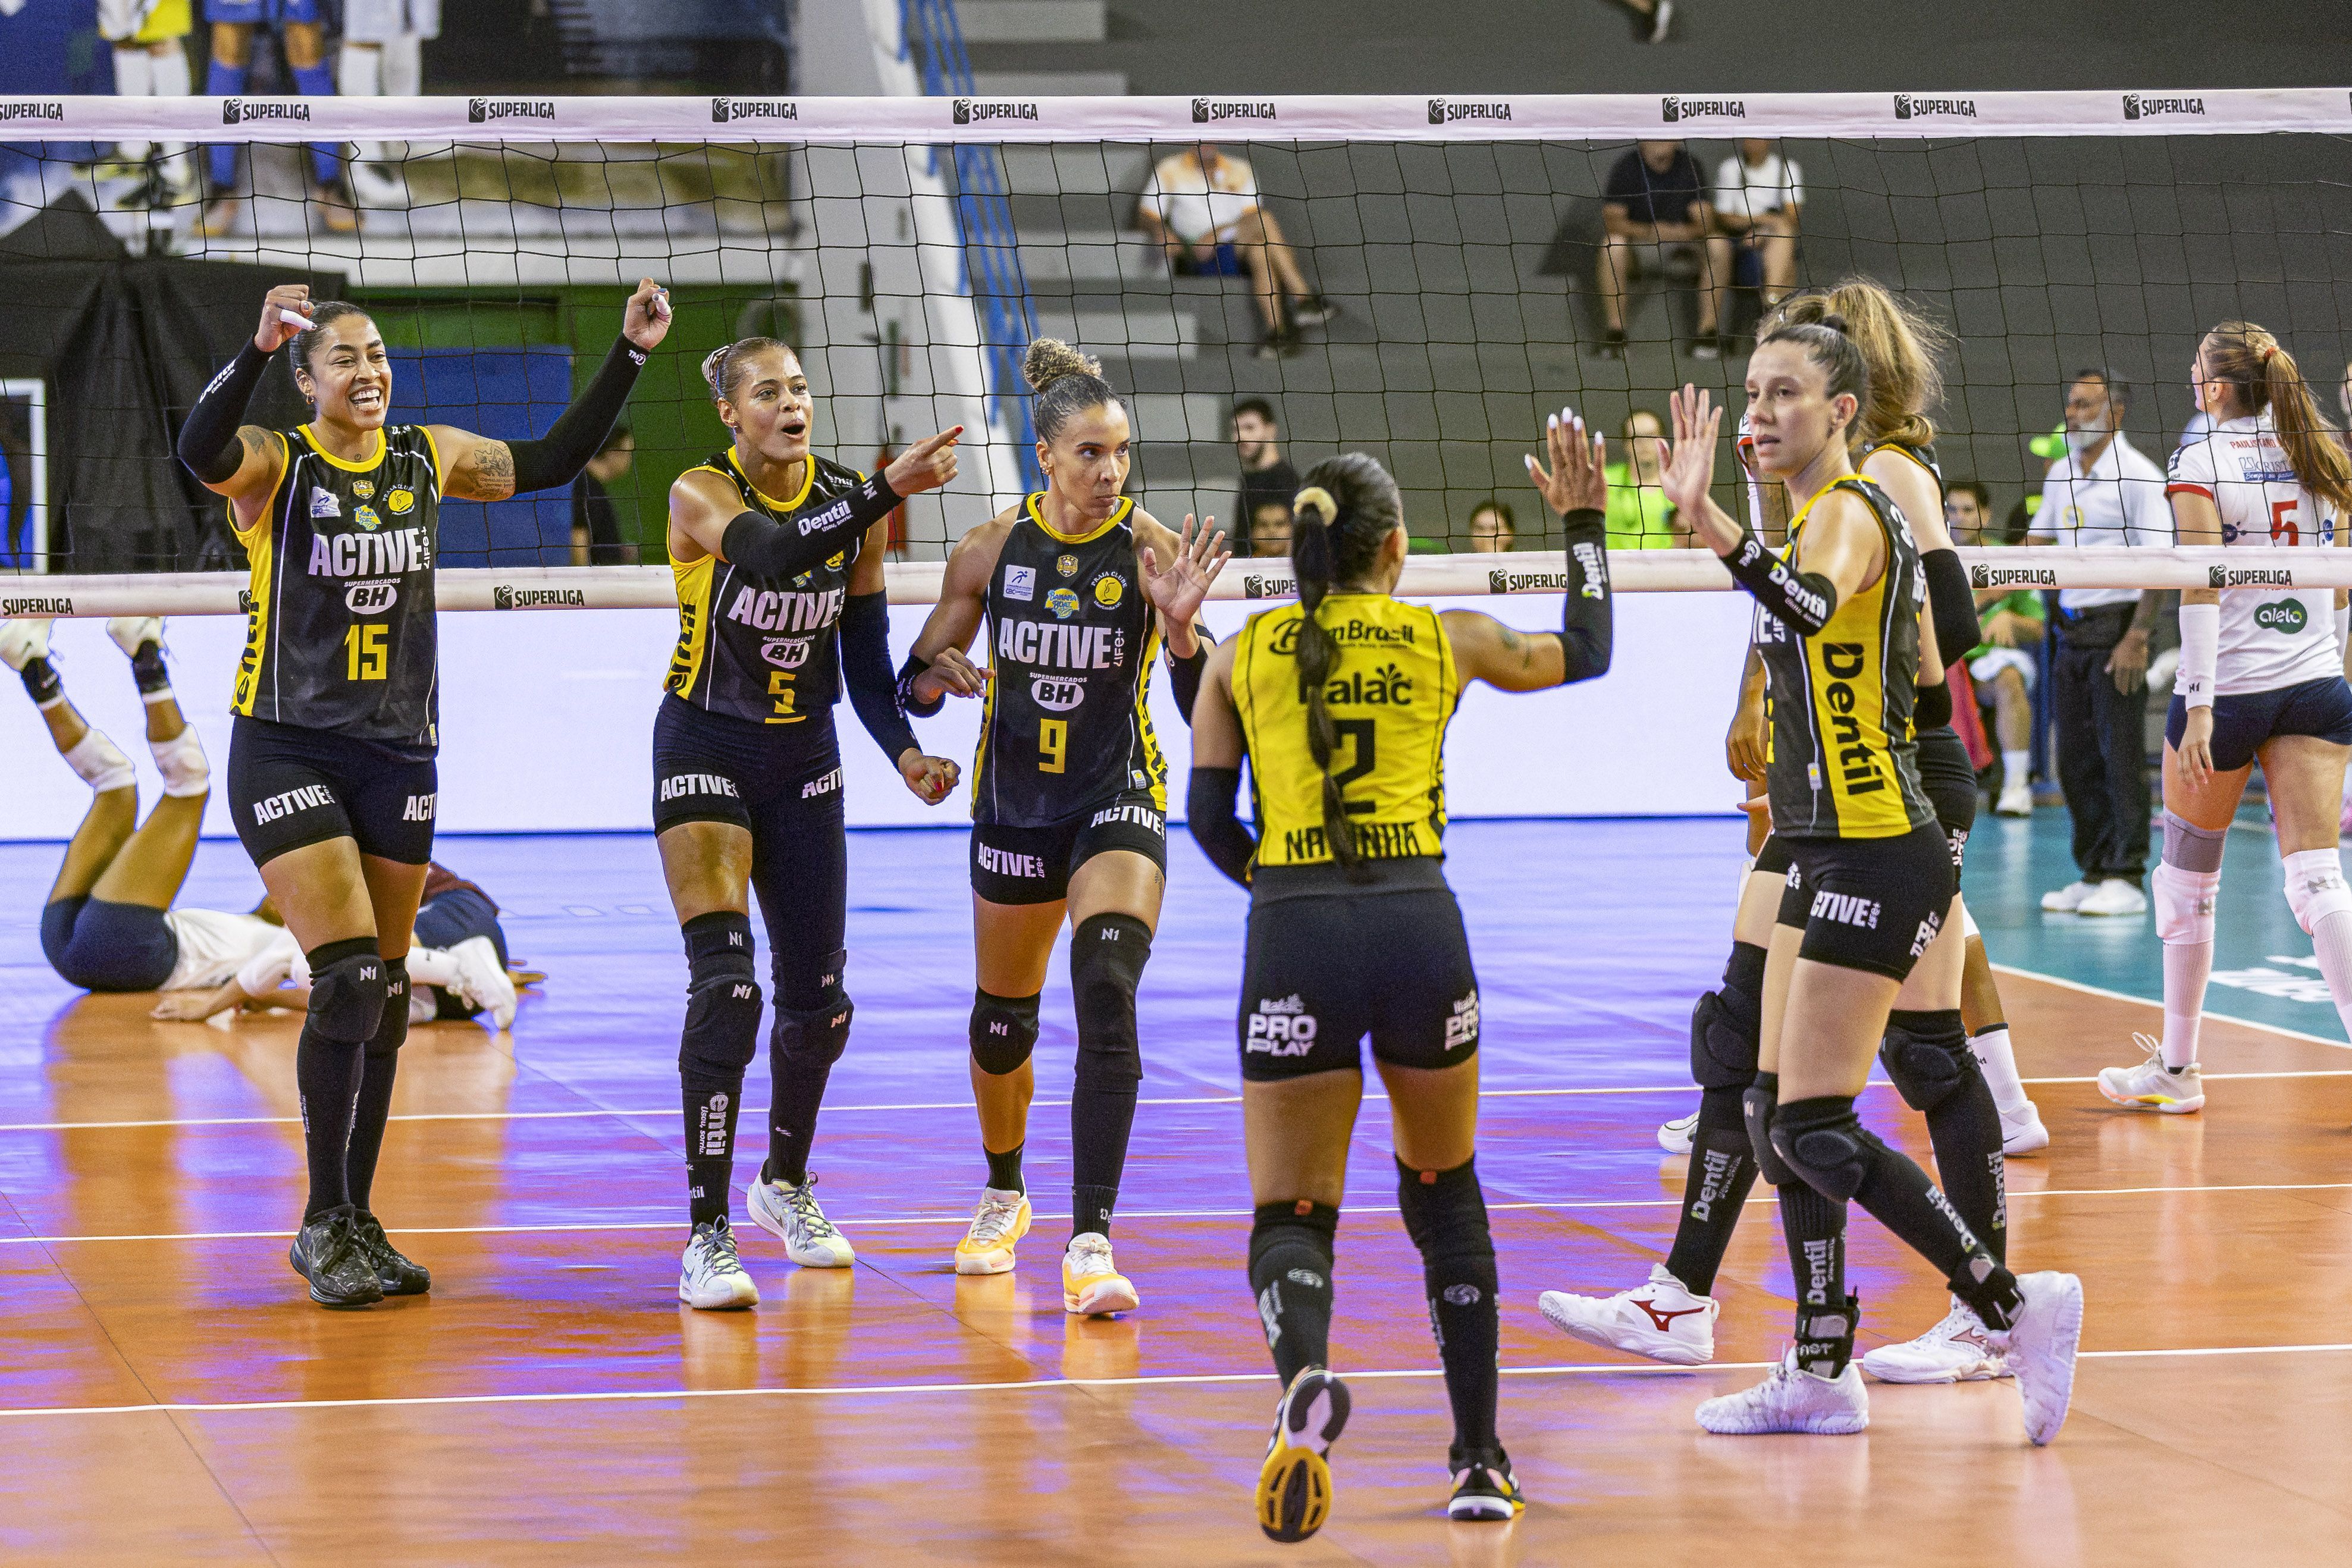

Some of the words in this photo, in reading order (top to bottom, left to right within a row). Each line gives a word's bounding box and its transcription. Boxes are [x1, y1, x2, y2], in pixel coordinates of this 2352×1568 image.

[243, 103, 310, 121] SUPERLIGA
[488, 102, 554, 120] SUPERLIGA
[732, 102, 798, 120] SUPERLIGA
[973, 103, 1039, 121] SUPERLIGA
[1212, 102, 1277, 120] SUPERLIGA
[1447, 104, 1511, 121] SUPERLIGA
[1682, 101, 1745, 118] SUPERLIGA
[1912, 99, 1977, 118] SUPERLIGA
[2141, 98, 2205, 115] SUPERLIGA
[798, 500, 851, 536] Dentil
[2272, 500, 2298, 546] 5
[308, 528, 422, 576] ACTIVE
[1091, 572, 1109, 587] PRAIA
[1111, 571, 1127, 588] CLUBE
[1573, 542, 1604, 600] Dentil
[1991, 569, 2056, 586] SUPERLIGA
[2228, 569, 2293, 586] SUPERLIGA
[344, 578, 400, 587] SUPERMERCADOS
[1509, 573, 1567, 591] SUPERLIG
[1768, 562, 1827, 620] Dentil
[2, 597, 74, 615] SUPERLIGA
[352, 587, 390, 607] BH
[514, 587, 584, 607] SUPERLIGA
[727, 585, 840, 632] ACTIVE
[2260, 608, 2302, 625] alelo
[344, 624, 388, 680] 15
[999, 617, 1112, 669] ACTIVE
[767, 644, 804, 663] BH
[1029, 672, 1087, 683] SUPERMERCADOS
[766, 671, 803, 723] 5
[1037, 683, 1077, 704] BH
[1822, 642, 1884, 795] Dentil
[1039, 718, 1067, 773] 9
[1330, 719, 1376, 814] 2
[661, 774, 733, 802] ACTIVE
[253, 785, 329, 825] ACTIVE
[1090, 805, 1164, 836] ACTIVE
[978, 842, 1036, 878] ACTIVE
[1810, 890, 1871, 927] CTIVE
[729, 932, 742, 946] N1
[1101, 928, 1119, 940] N1
[360, 967, 377, 981] N1
[732, 984, 752, 999] N1
[990, 1021, 1008, 1036] N1
[1249, 1014, 1318, 1041] PRO
[706, 1092, 729, 1155] entil
[1691, 1149, 1731, 1222] Dentil
[1803, 1240, 1827, 1305] Dentil
